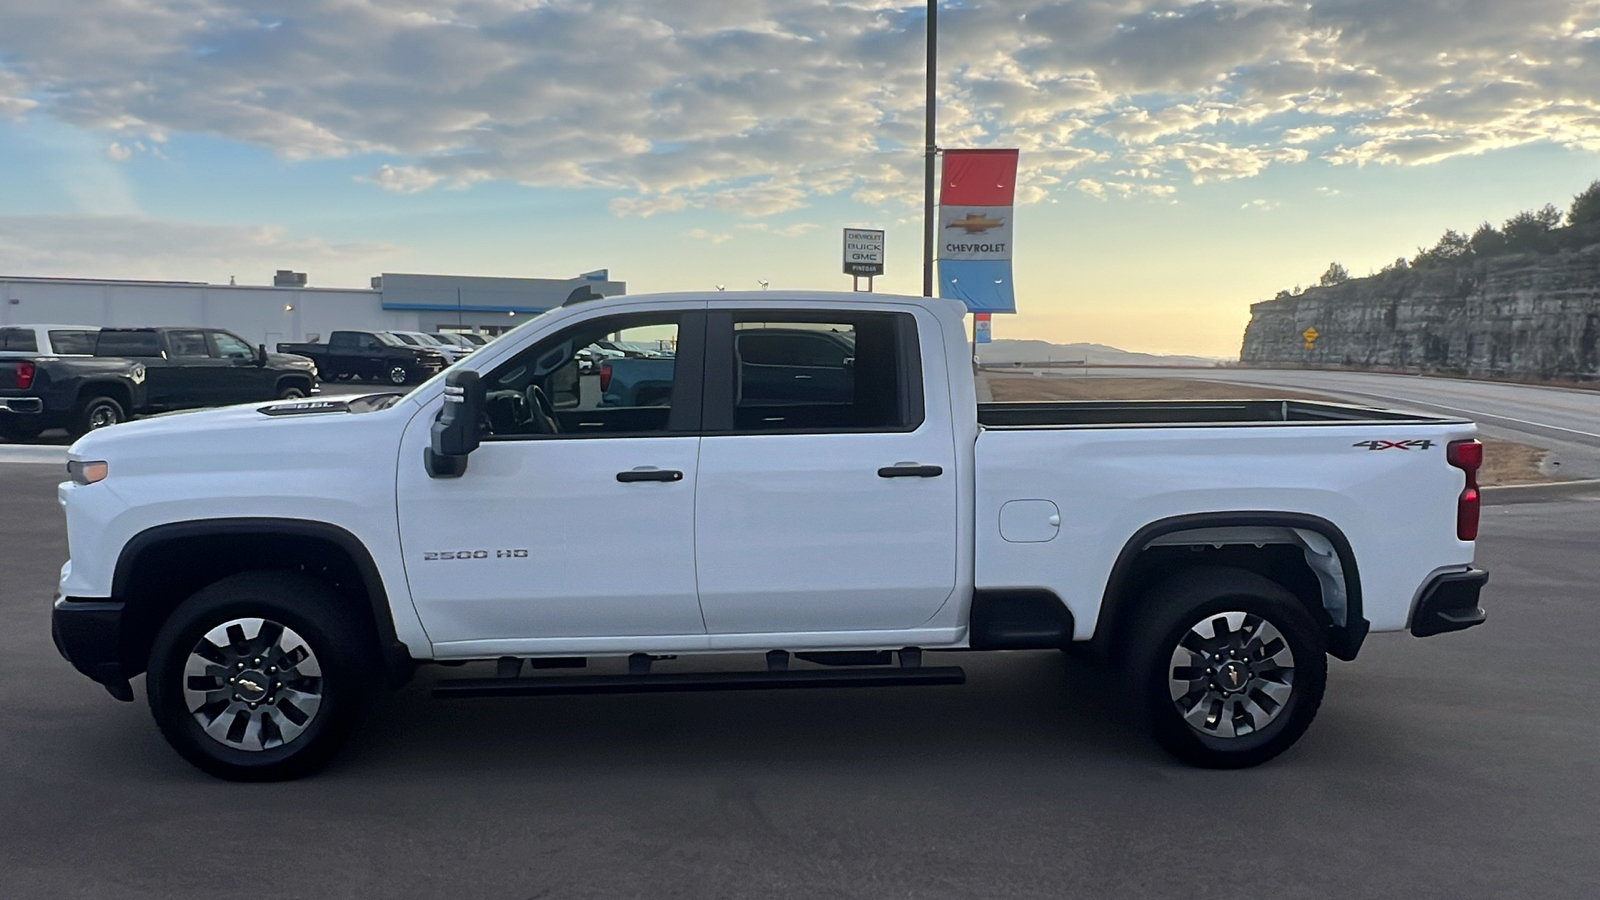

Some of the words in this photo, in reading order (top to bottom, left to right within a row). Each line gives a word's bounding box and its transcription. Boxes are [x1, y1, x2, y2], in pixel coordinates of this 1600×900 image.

[848, 233, 882, 241] CHEVROLET
[847, 243, 881, 251] BUICK
[946, 243, 1005, 253] CHEVROLET
[852, 253, 877, 261] GMC
[423, 550, 488, 561] 2500
[496, 549, 529, 559] HD
